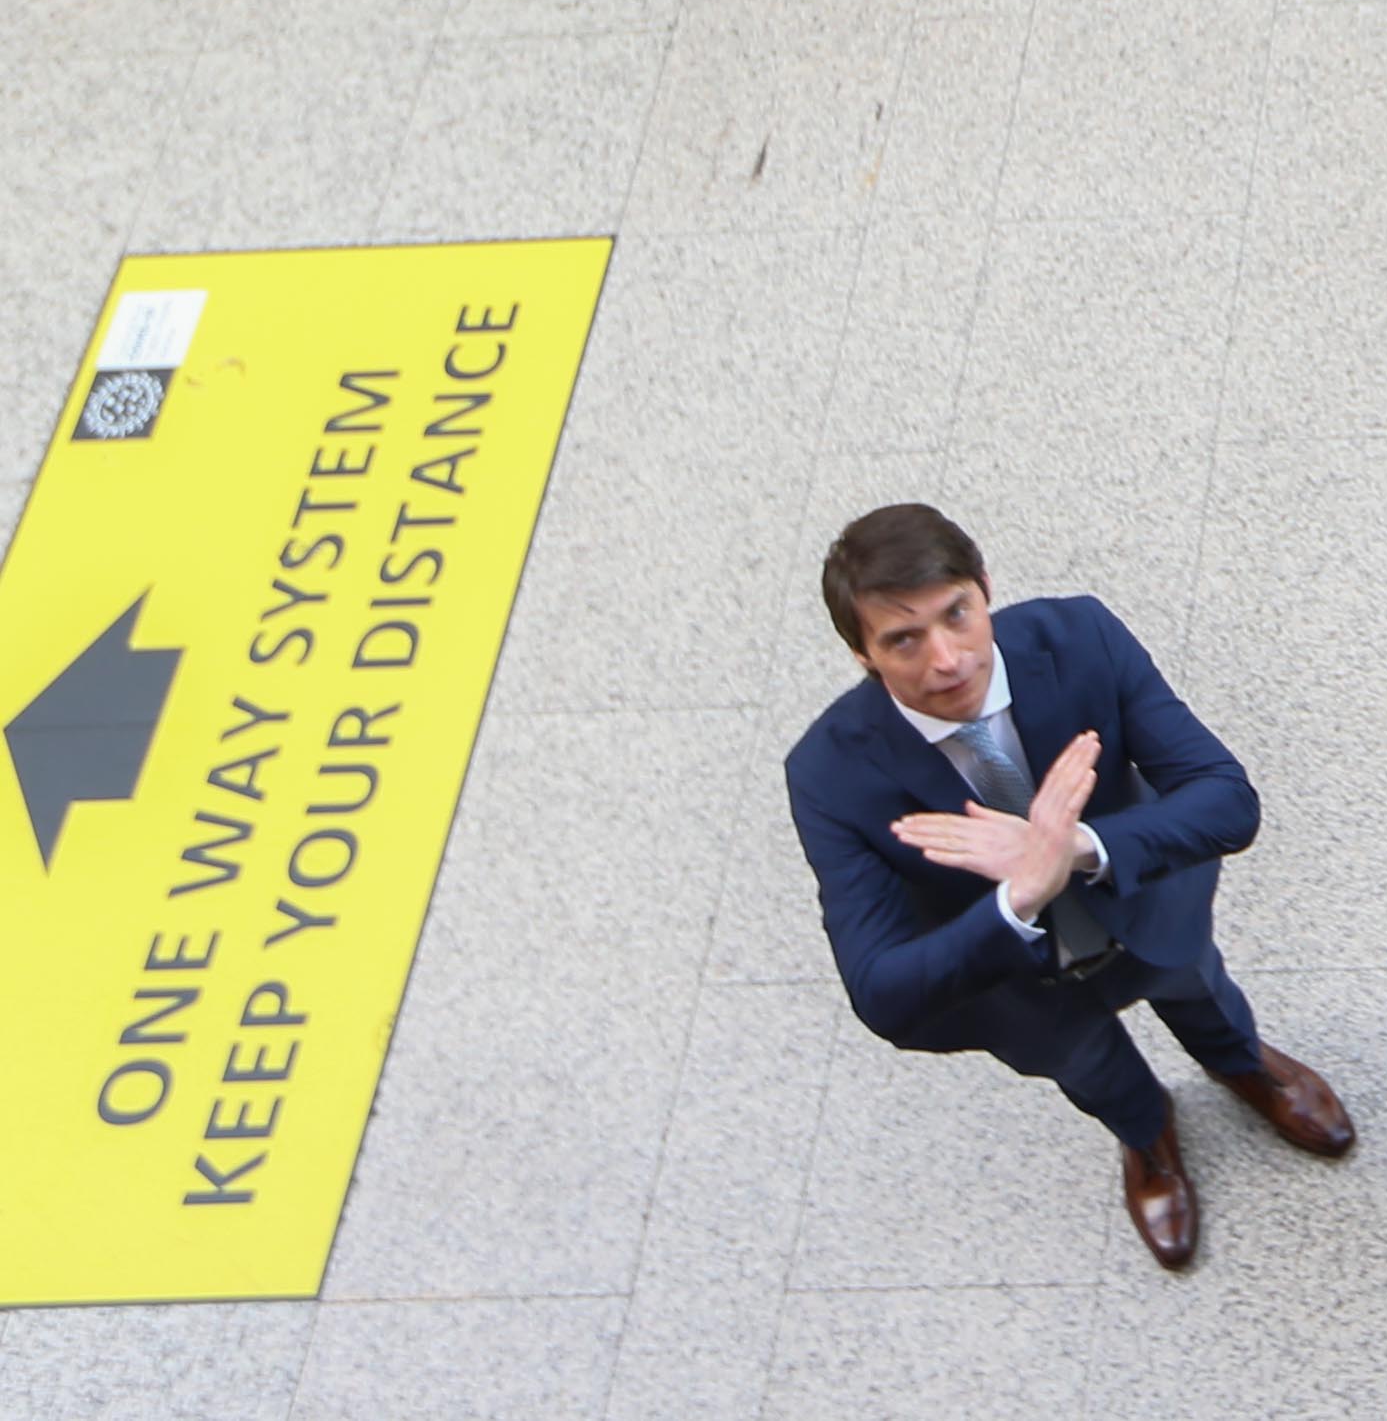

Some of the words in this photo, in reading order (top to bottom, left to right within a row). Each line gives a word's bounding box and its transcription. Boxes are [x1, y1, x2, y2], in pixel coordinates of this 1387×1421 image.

[97, 930, 221, 1126] ONE
[168, 695, 292, 898] WAY
[249, 370, 401, 667] SYSTEM
[182, 980, 309, 1206] KEEP
[264, 701, 403, 949] YOUR
[351, 302, 521, 670] DISTANCE
